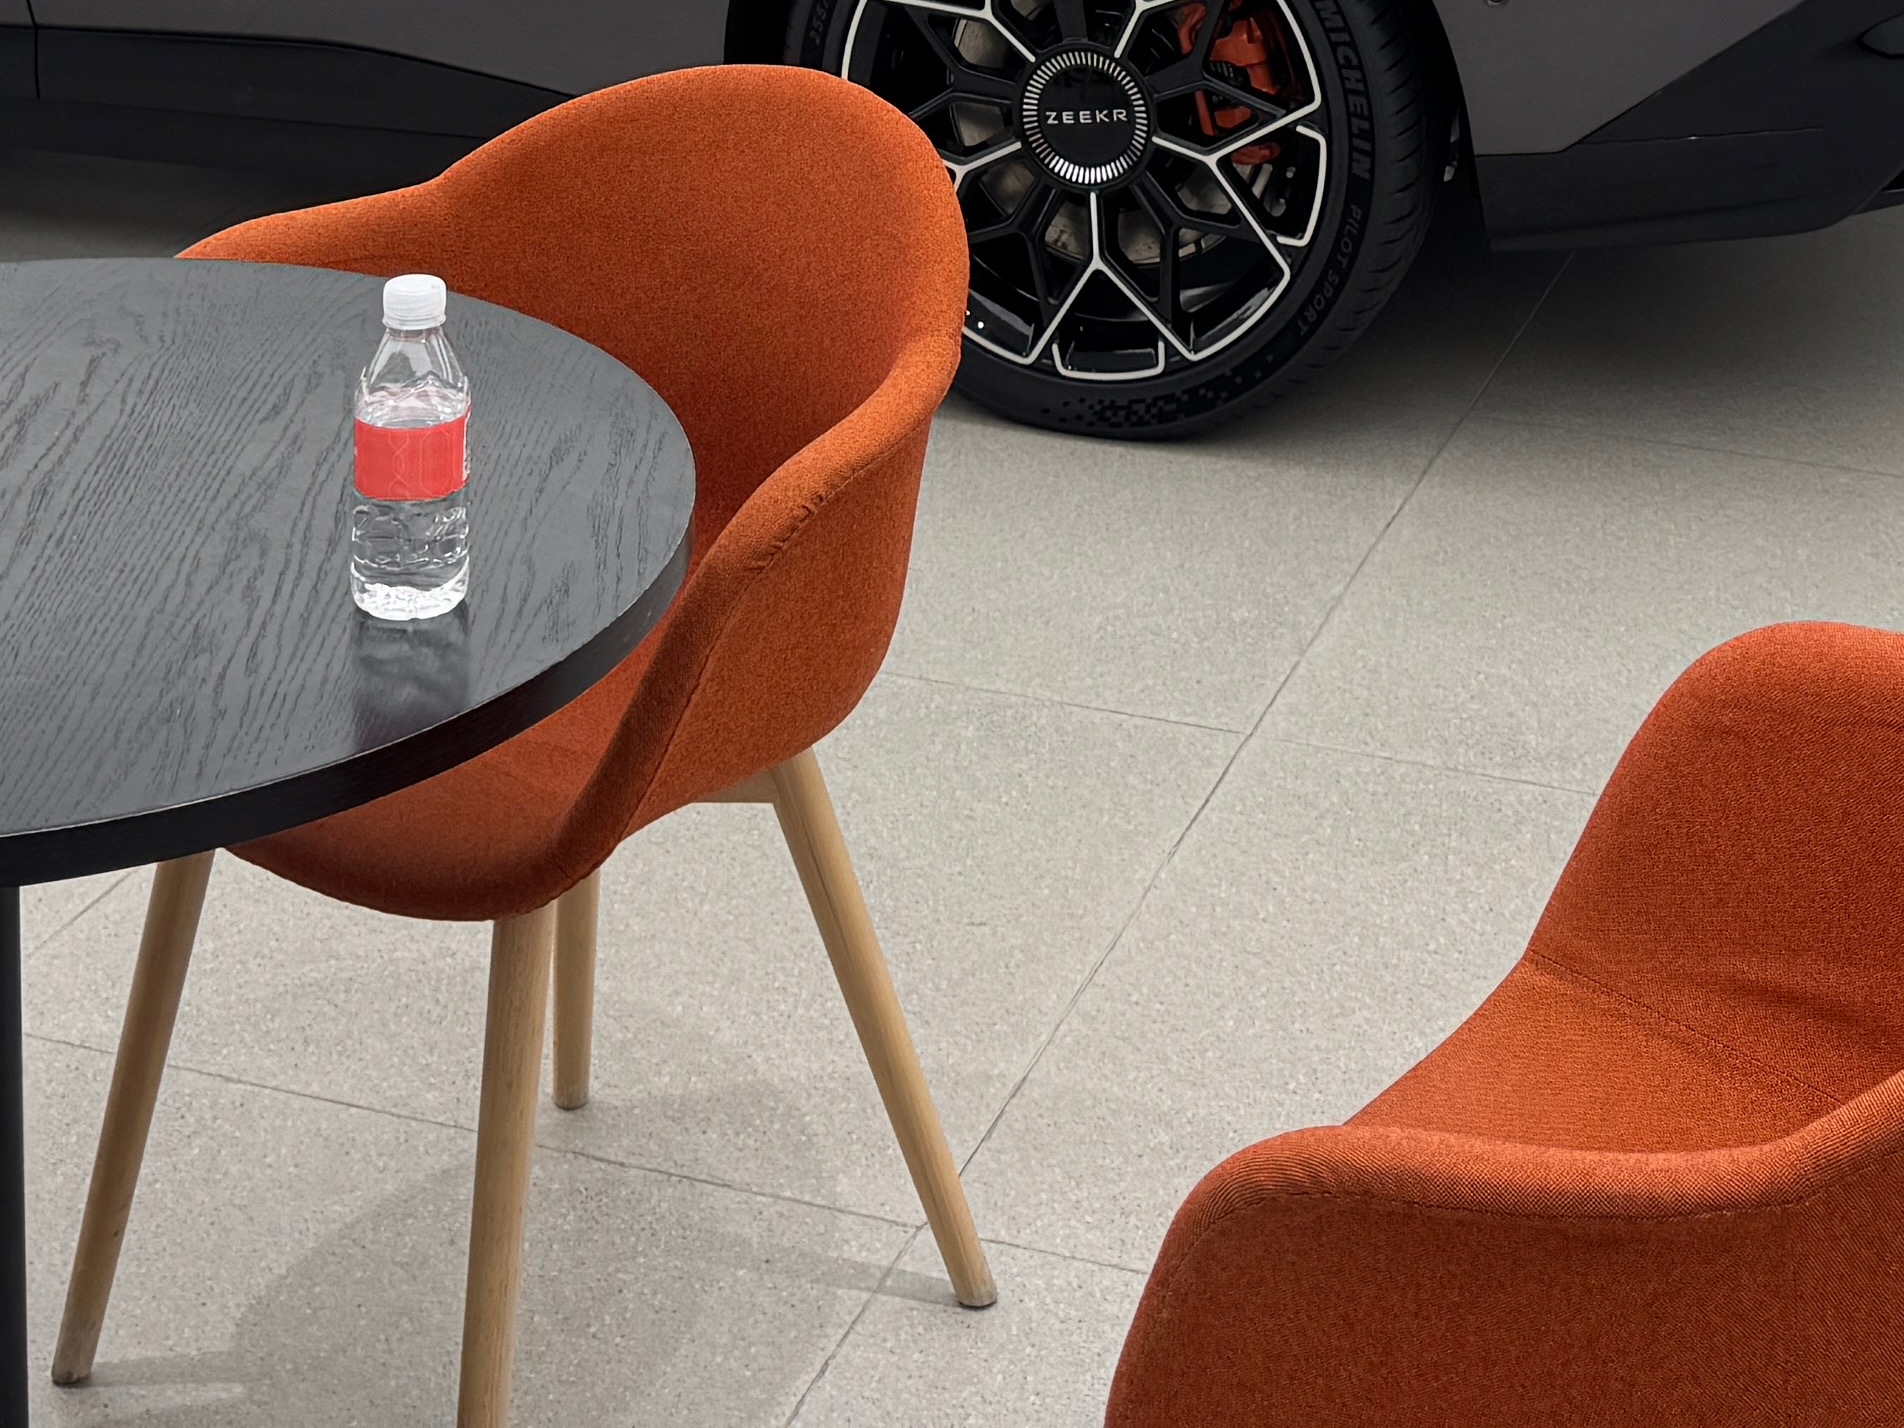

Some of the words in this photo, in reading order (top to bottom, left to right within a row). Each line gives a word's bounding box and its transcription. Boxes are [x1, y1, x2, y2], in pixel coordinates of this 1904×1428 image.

[1045, 106, 1129, 127] ZEEKR
[1336, 204, 1363, 270] PILOT
[1298, 270, 1341, 336] SPORT
